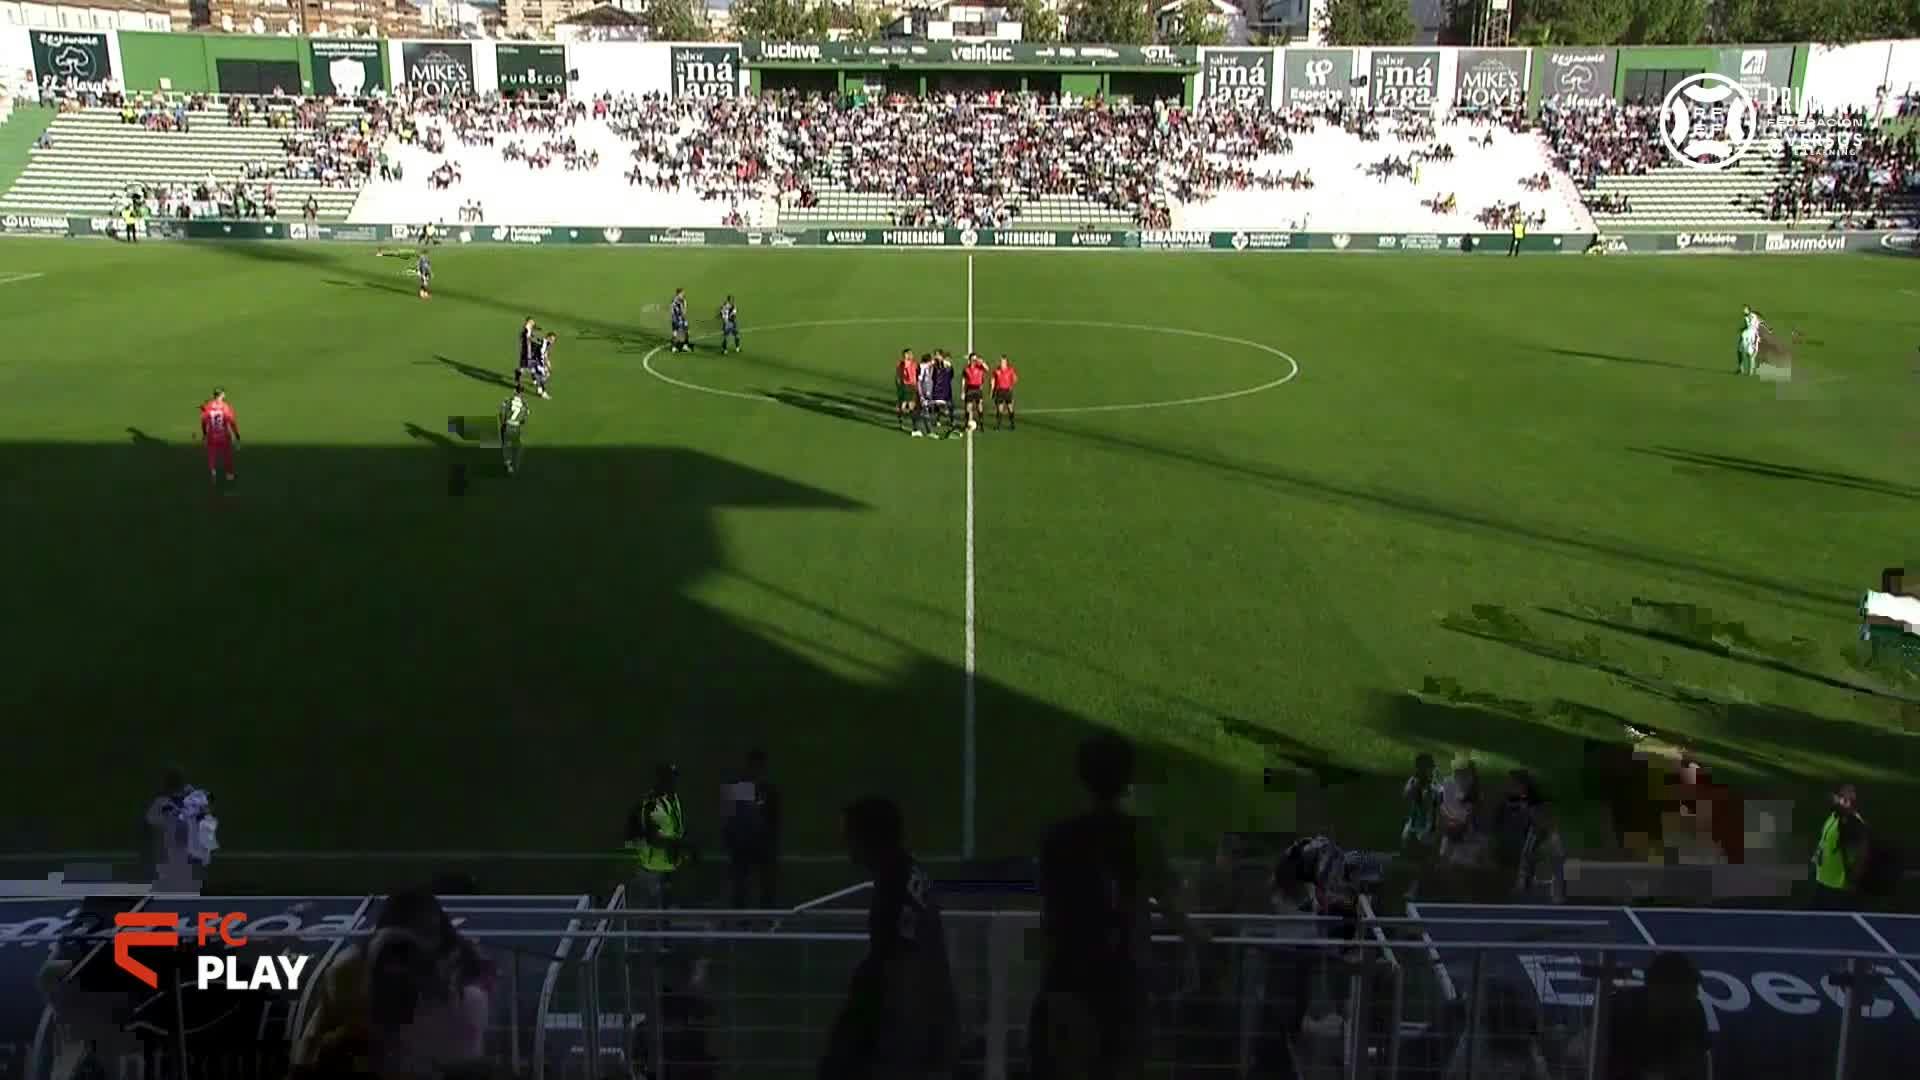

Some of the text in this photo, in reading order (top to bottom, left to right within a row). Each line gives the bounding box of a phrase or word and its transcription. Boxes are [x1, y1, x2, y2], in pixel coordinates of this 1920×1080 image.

[676, 50, 703, 62] sabor
[1209, 54, 1238, 65] sabor
[1376, 54, 1404, 65] sabor
[411, 63, 468, 81] MIKE'S
[1462, 70, 1518, 88] MIKE'S
